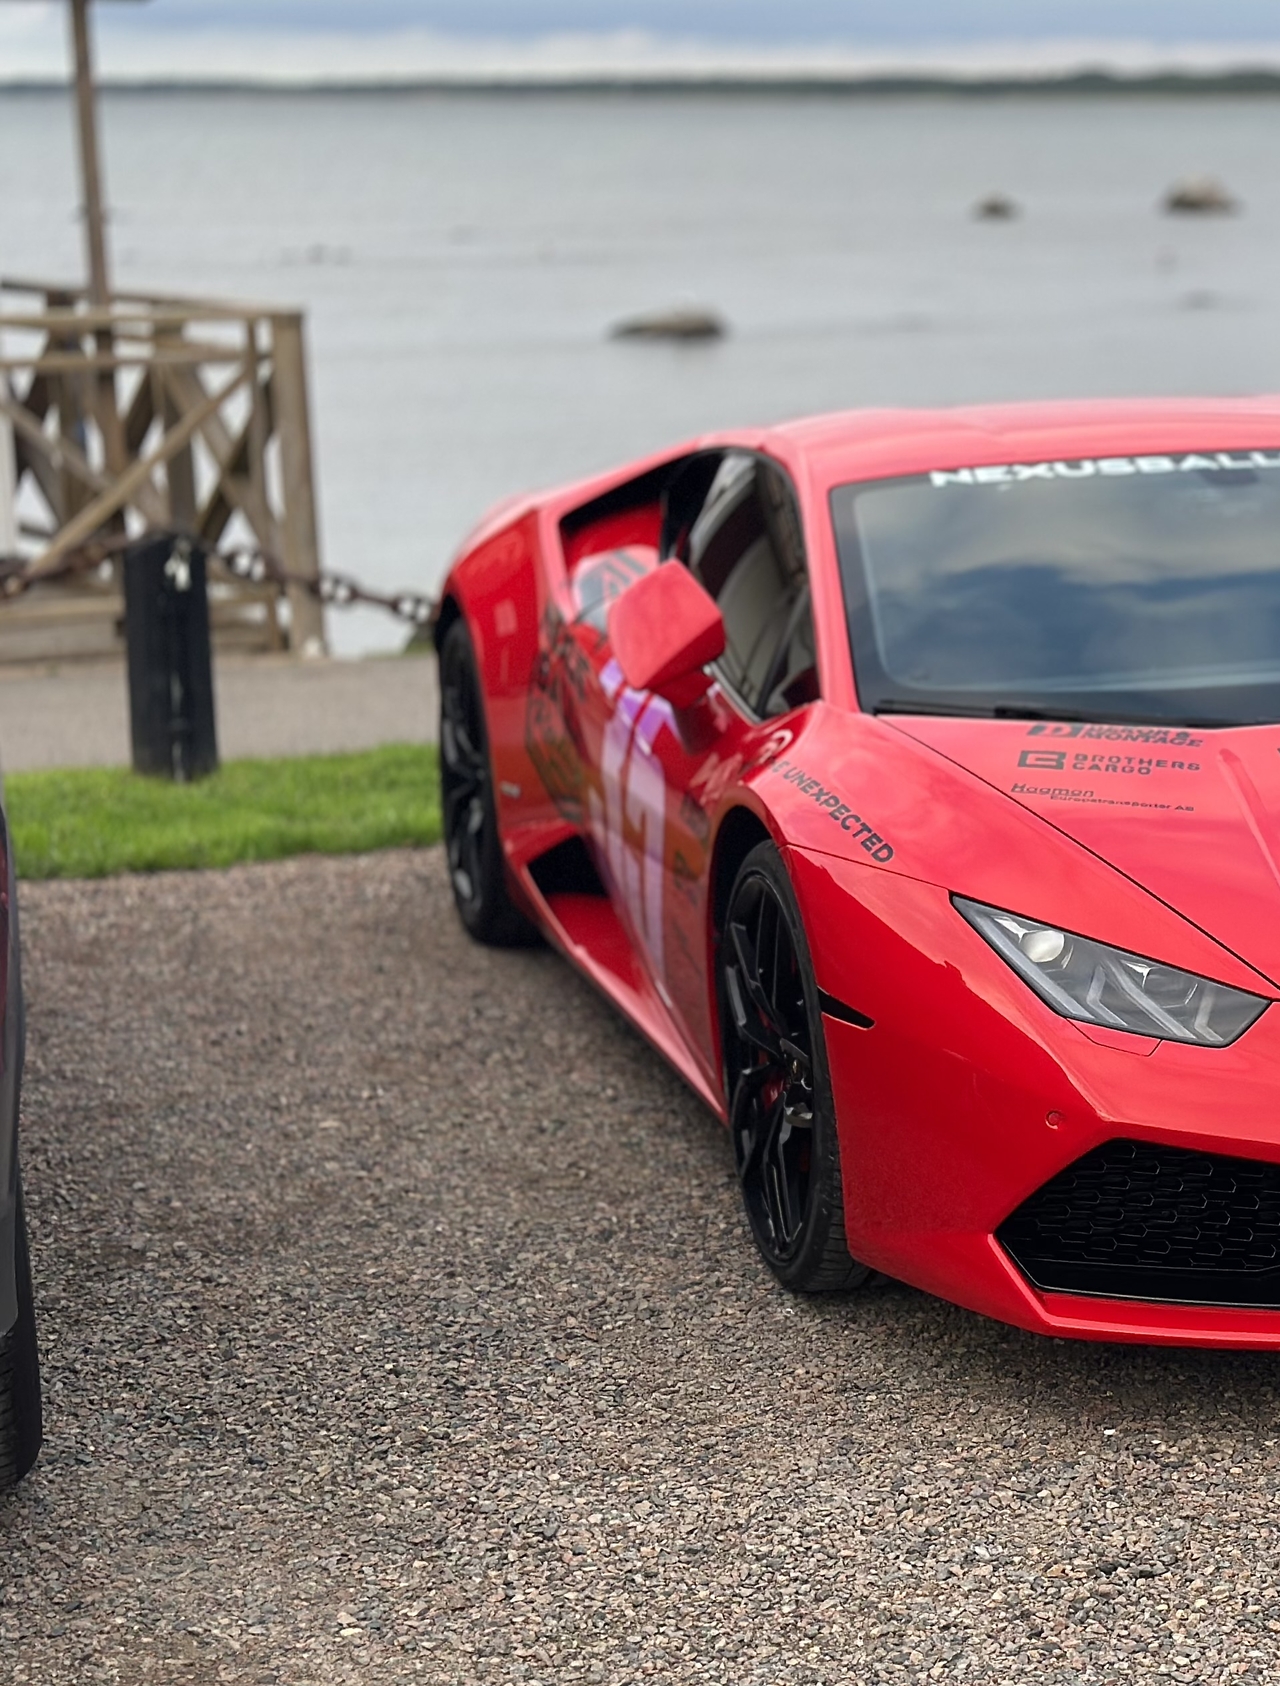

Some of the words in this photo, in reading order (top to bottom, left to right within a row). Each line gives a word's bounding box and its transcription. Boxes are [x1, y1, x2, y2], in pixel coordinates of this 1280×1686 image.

[1081, 731, 1203, 747] MONTAGE
[1072, 762, 1151, 775] CARGO
[1074, 753, 1200, 771] BROTHERS
[783, 767, 894, 863] UNEXPECTED
